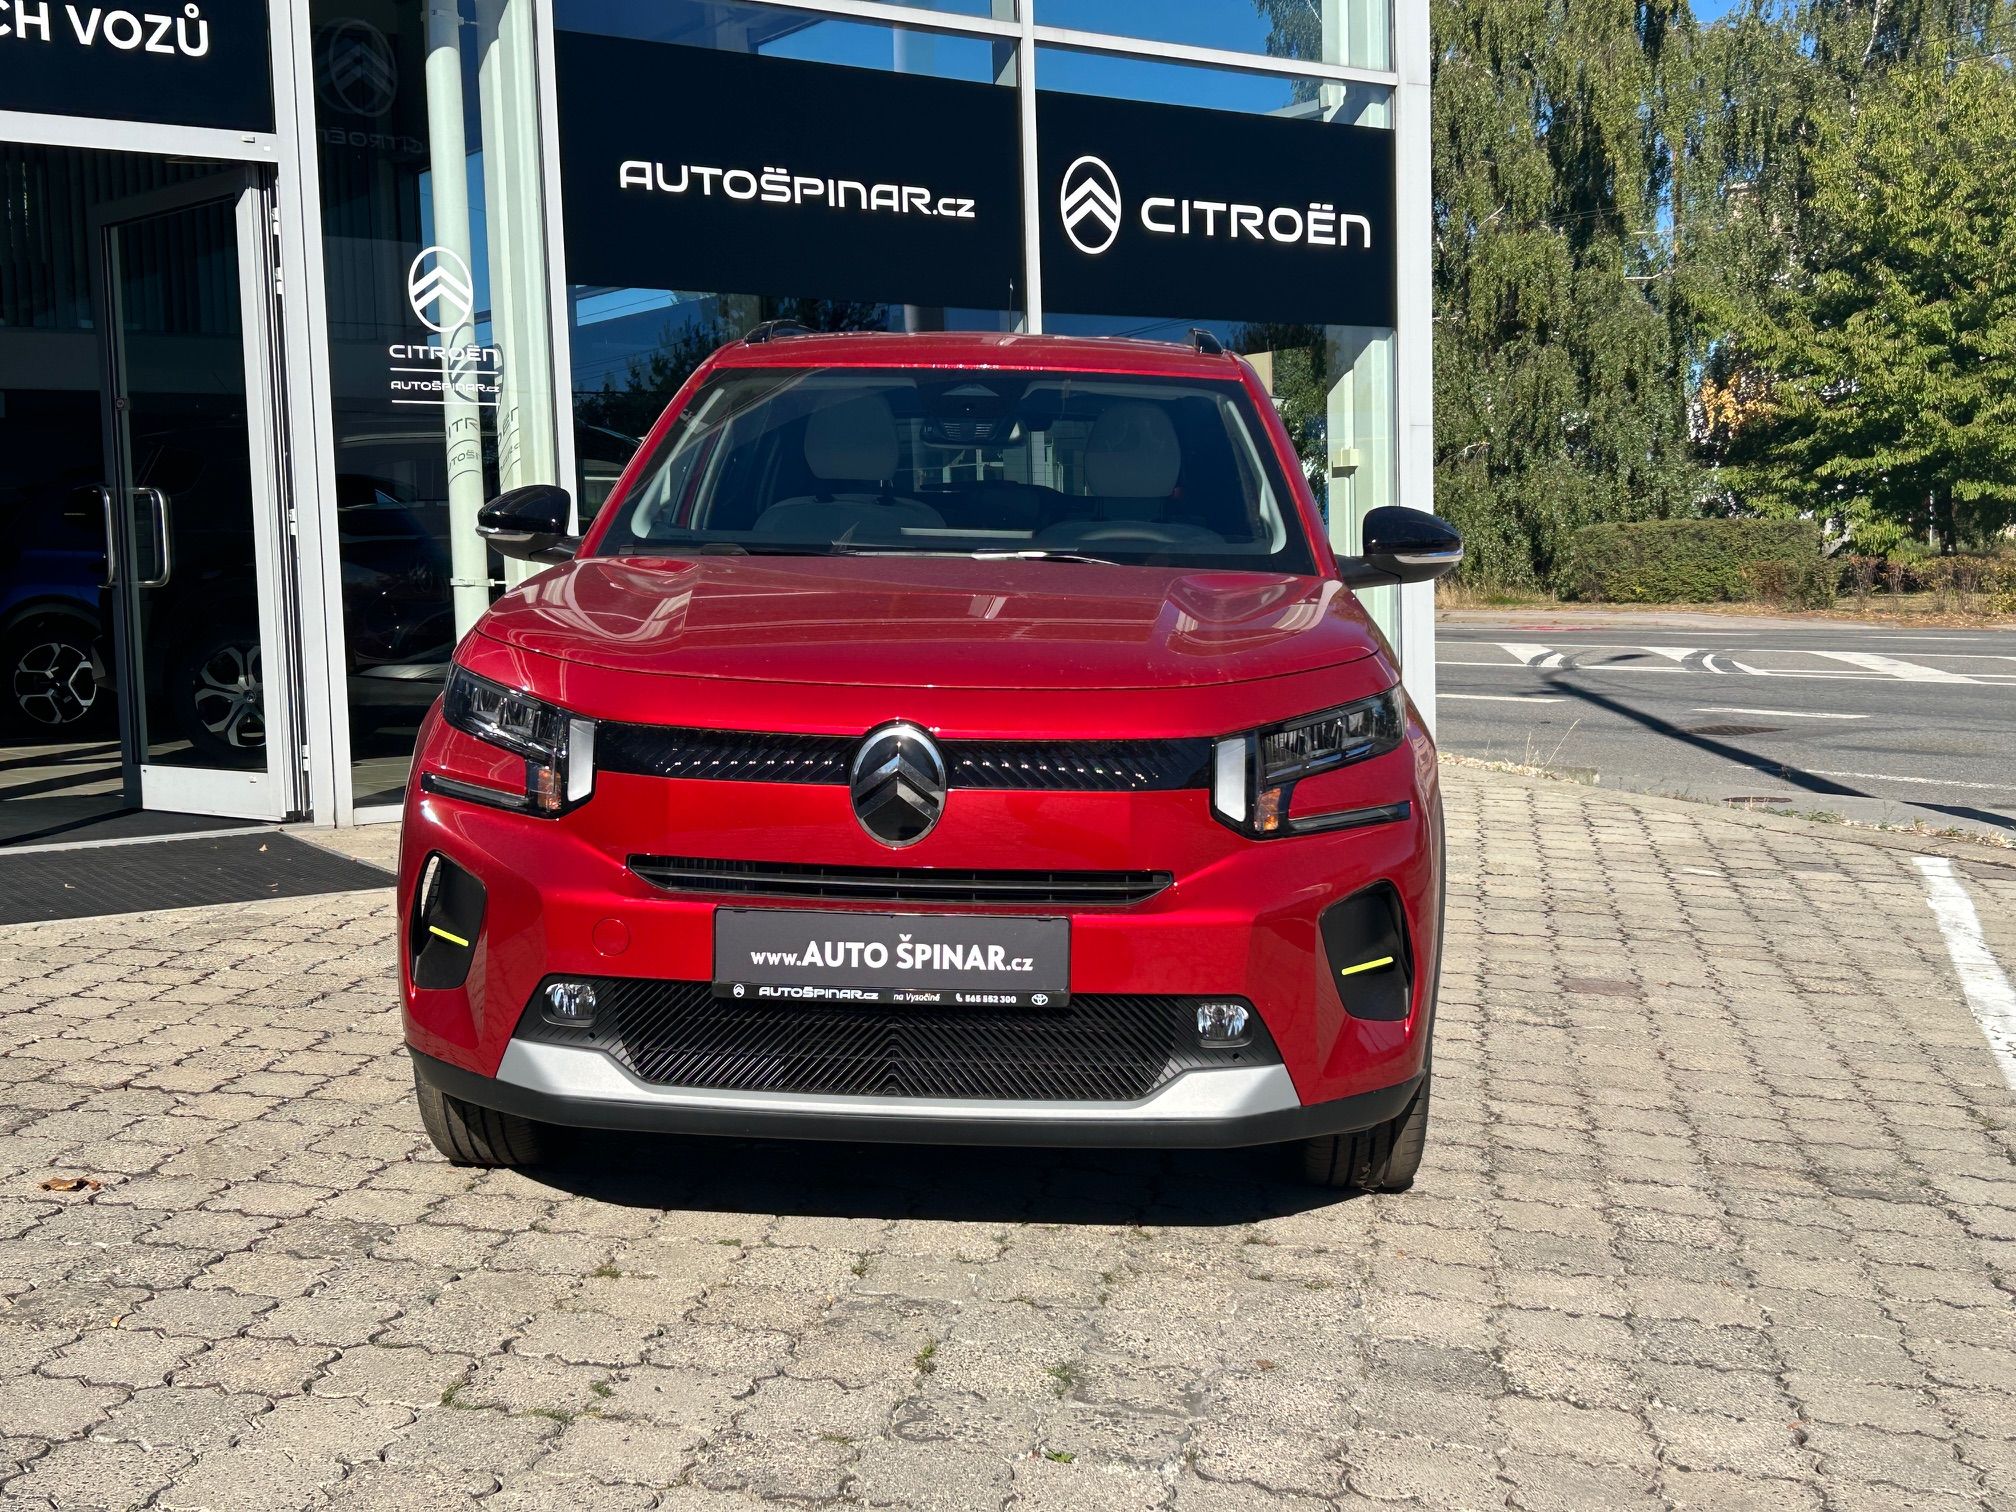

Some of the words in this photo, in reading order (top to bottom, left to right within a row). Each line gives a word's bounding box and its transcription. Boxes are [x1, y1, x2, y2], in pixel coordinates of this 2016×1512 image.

[65, 3, 209, 57] VOZŮ
[750, 940, 889, 969] www.AUTO
[895, 934, 1034, 971] ŠPINAR.cz
[893, 993, 904, 1001] na
[999, 995, 1017, 1004] 300
